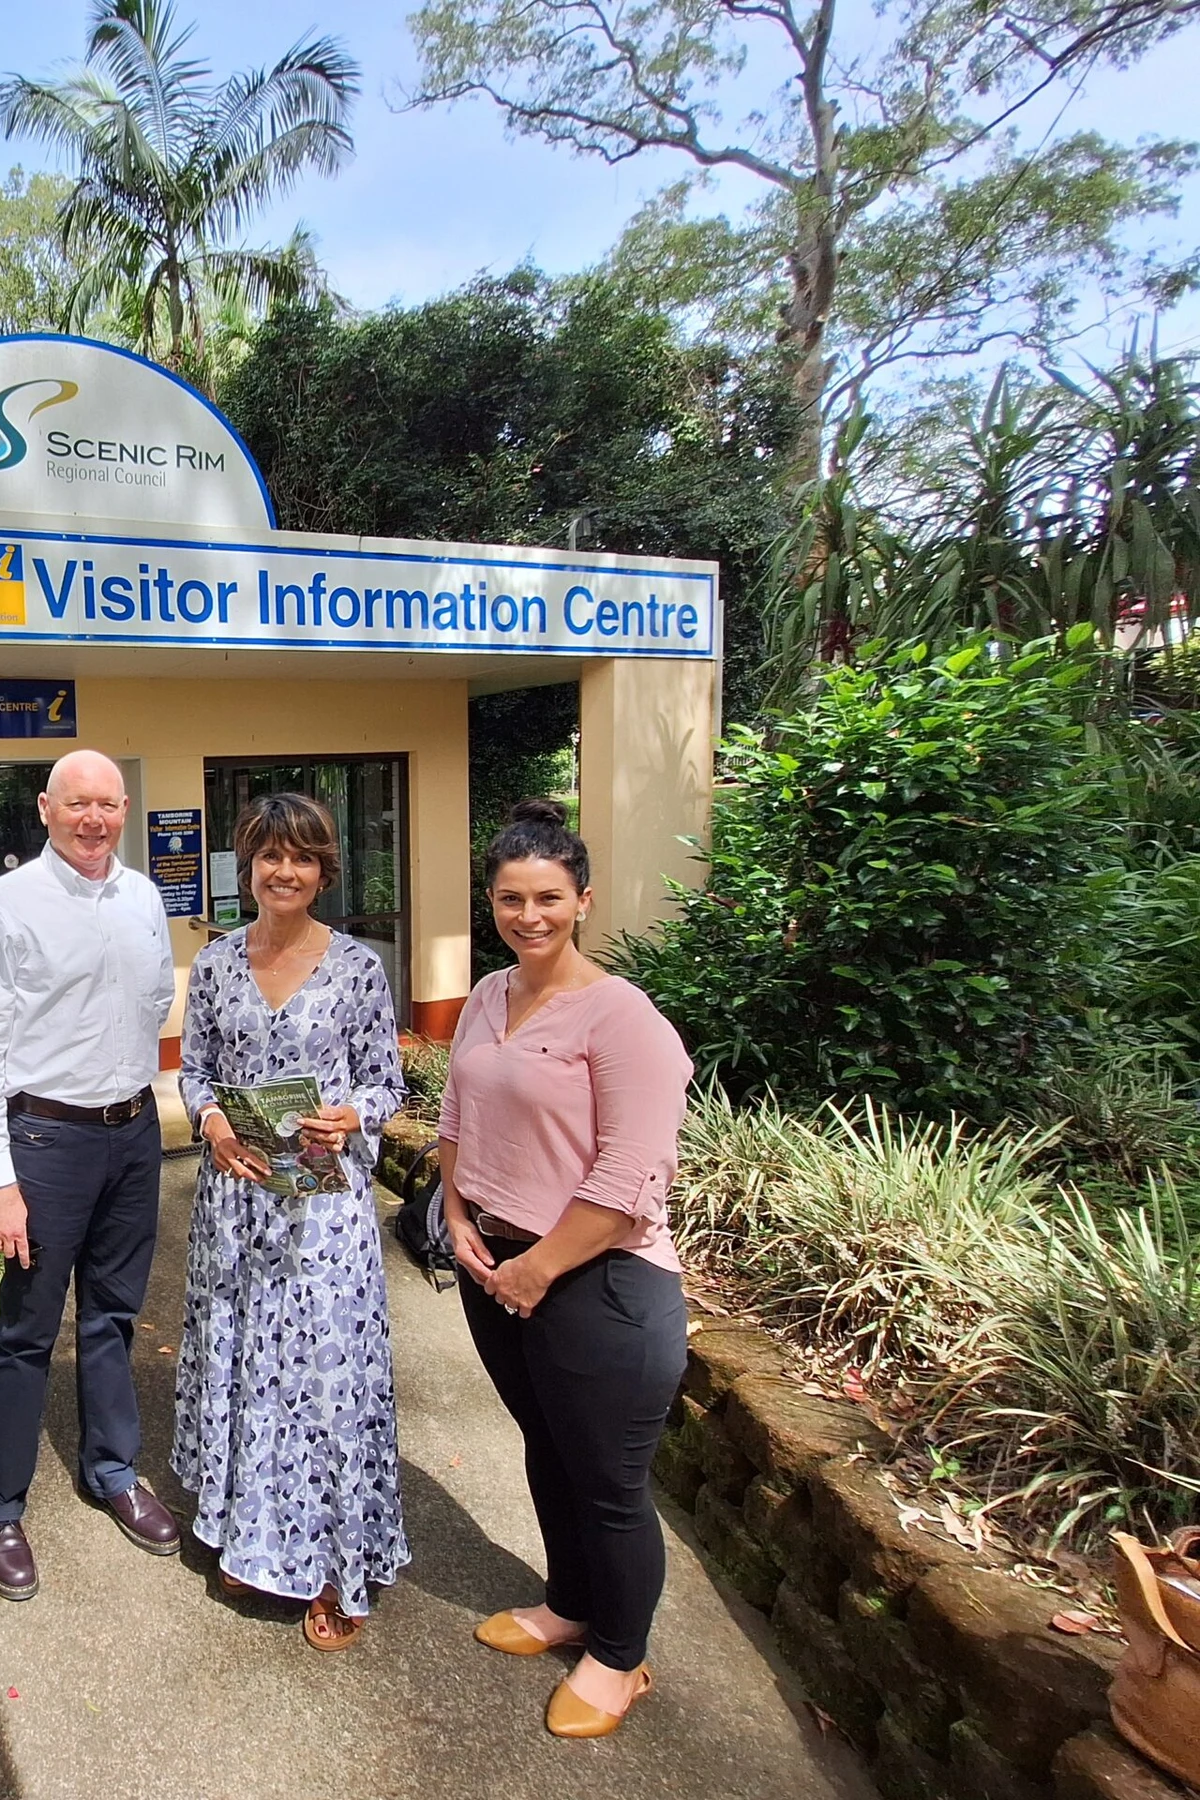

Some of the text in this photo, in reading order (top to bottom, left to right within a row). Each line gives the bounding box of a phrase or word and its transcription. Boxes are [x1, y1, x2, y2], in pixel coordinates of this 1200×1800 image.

[46, 431, 225, 472] SCENIC RIM
[46, 460, 166, 487] Regional Council
[32, 557, 238, 625] Visitor
[258, 570, 547, 634] Information
[563, 585, 698, 640] Centre
[0, 702, 39, 712] CENTRE
[259, 1093, 306, 1104] TAMBORINE
[262, 1099, 309, 1109] MOUNTAIN
